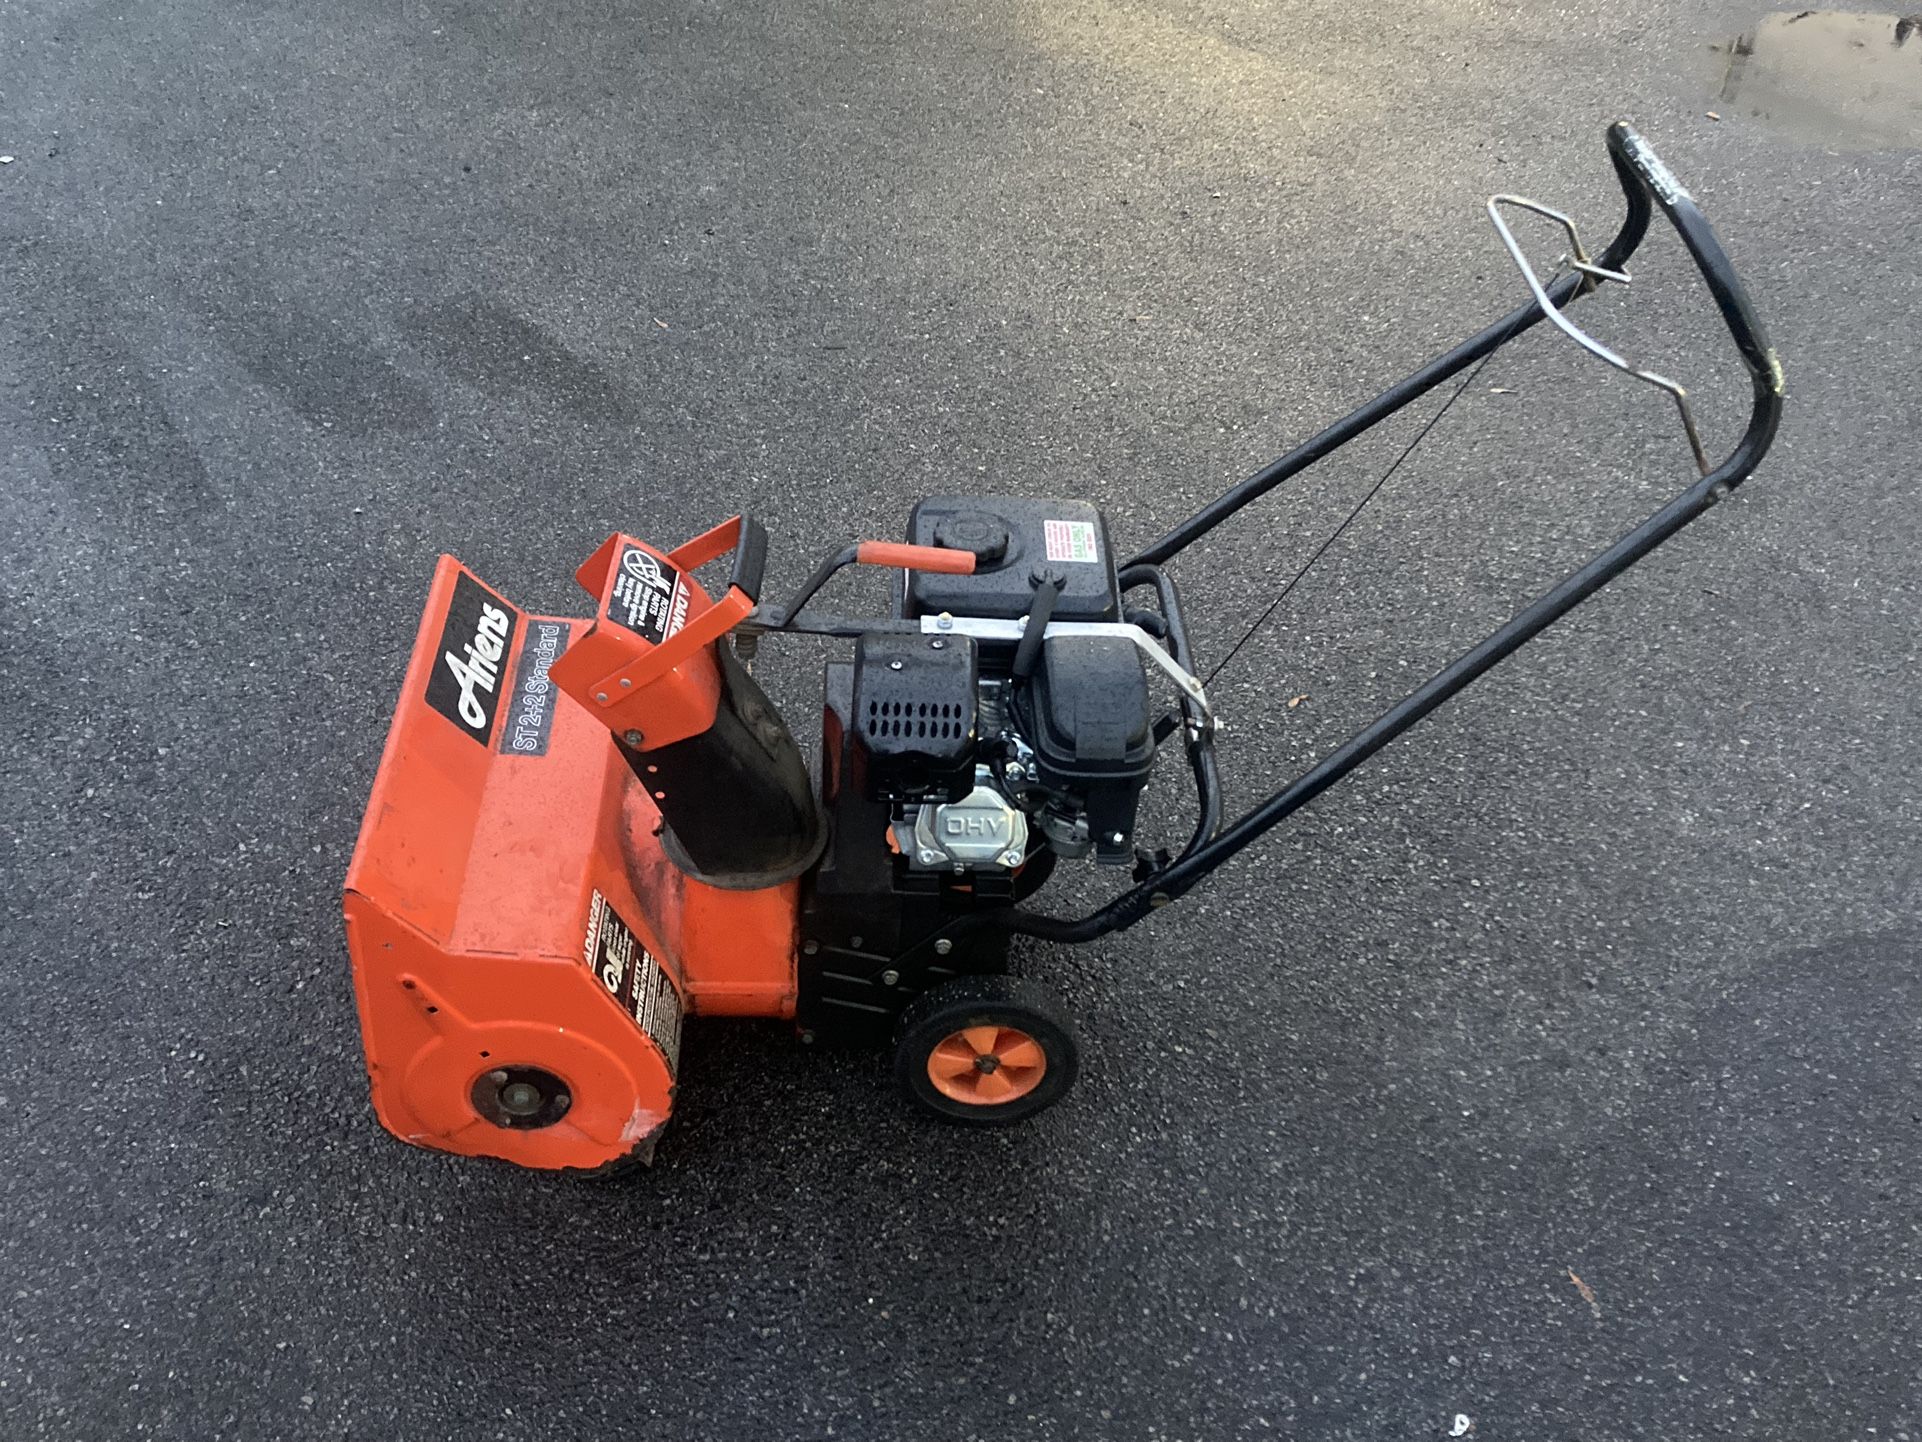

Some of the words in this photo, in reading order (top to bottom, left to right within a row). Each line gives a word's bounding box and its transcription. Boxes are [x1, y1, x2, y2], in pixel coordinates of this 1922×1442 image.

[649, 591, 661, 616] PARTS
[655, 597, 669, 632] ROTATING
[668, 594, 689, 638] DANG
[445, 602, 509, 729] Ariens
[525, 625, 560, 694] Standard
[519, 694, 546, 727] 2+2
[513, 726, 538, 751] ST
[946, 816, 1007, 837] OHV
[585, 889, 602, 950] DANGER
[632, 958, 642, 1000] SAFETY
[636, 950, 649, 1025] INSTRUCTIONS
